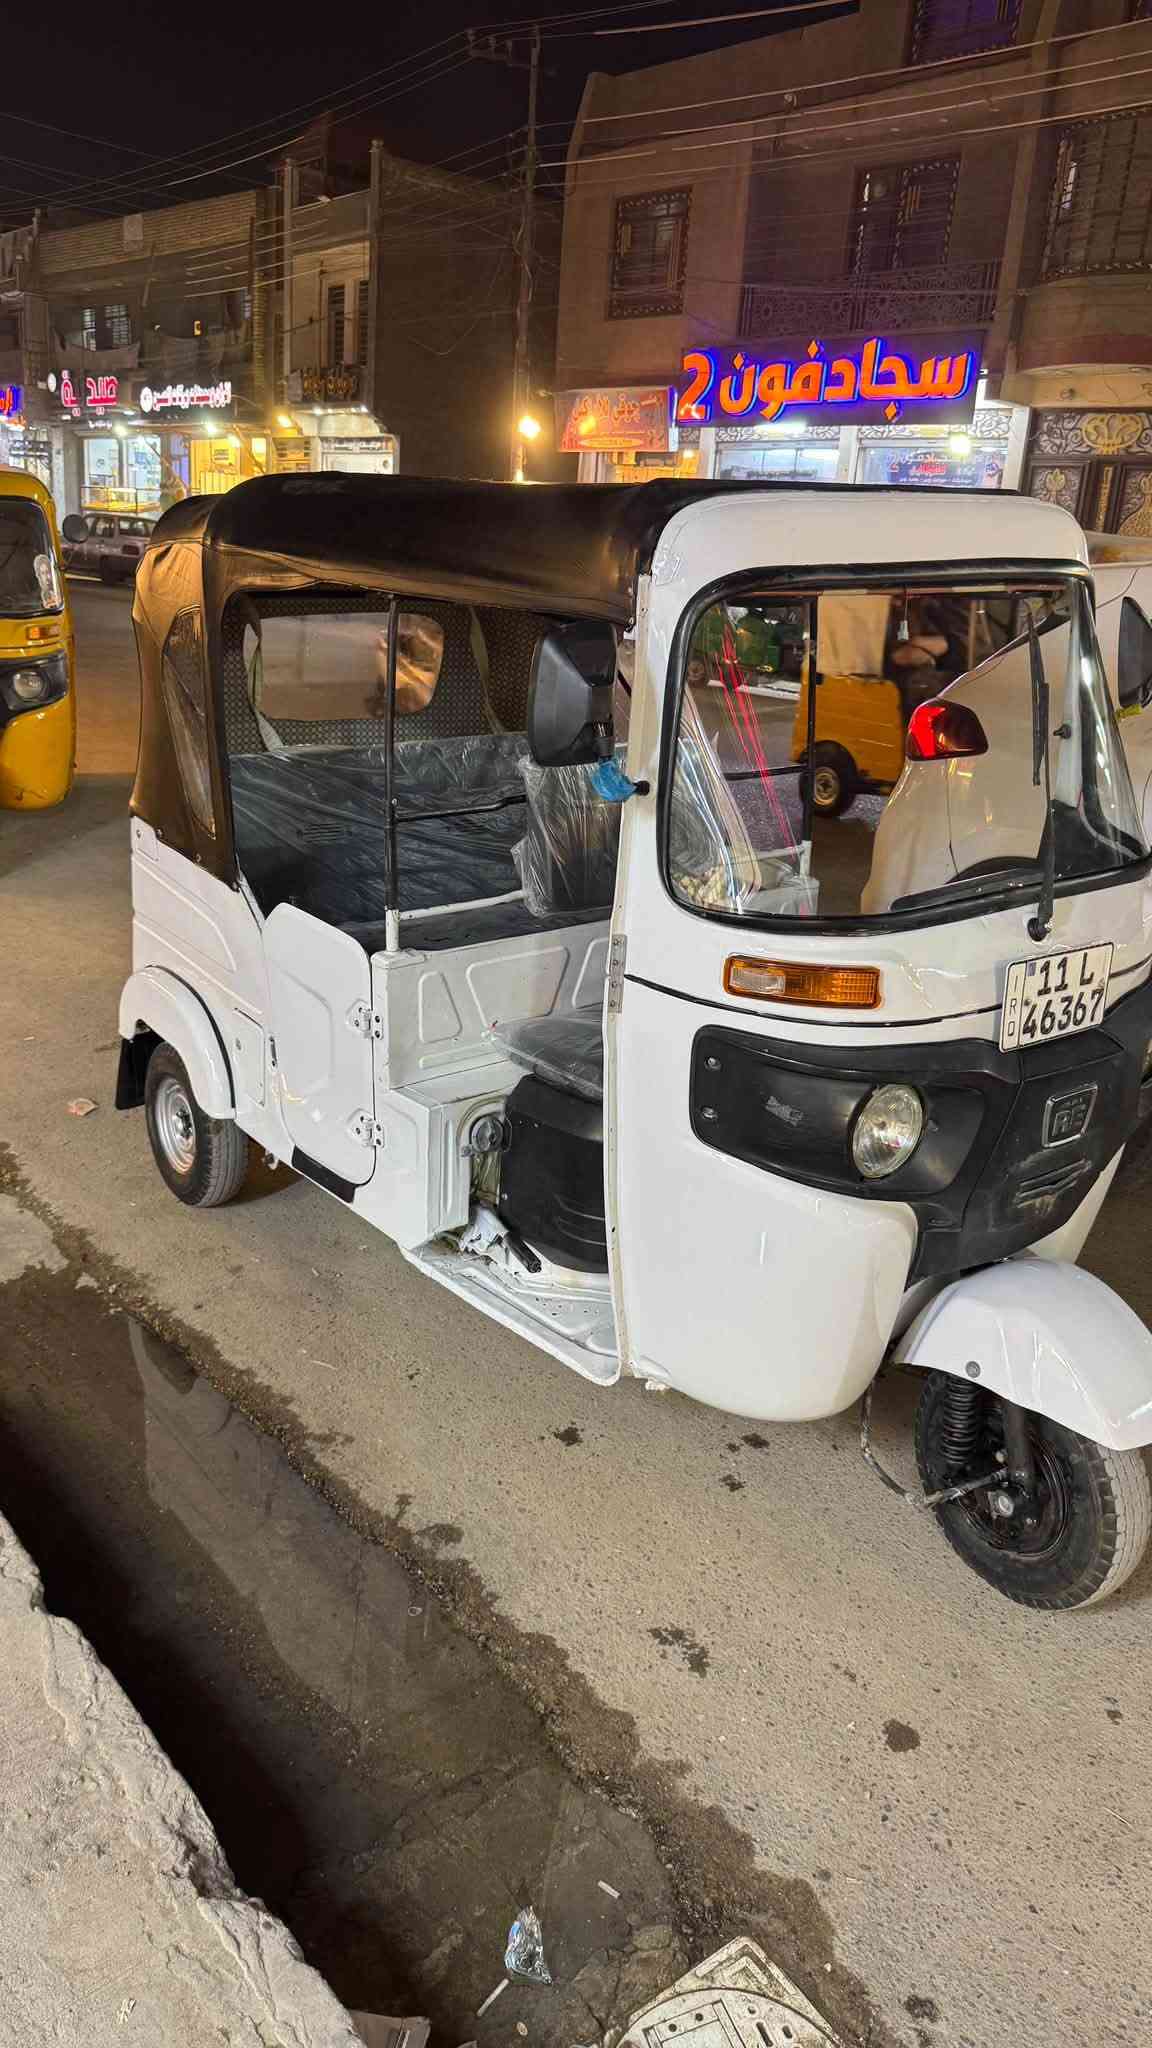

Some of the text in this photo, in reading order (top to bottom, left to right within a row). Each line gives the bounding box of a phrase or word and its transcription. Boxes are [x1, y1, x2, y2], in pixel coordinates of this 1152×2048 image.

[677, 351, 713, 422] 2
[1037, 951, 1095, 997] 11 L
[1022, 987, 1105, 1039] 46367
